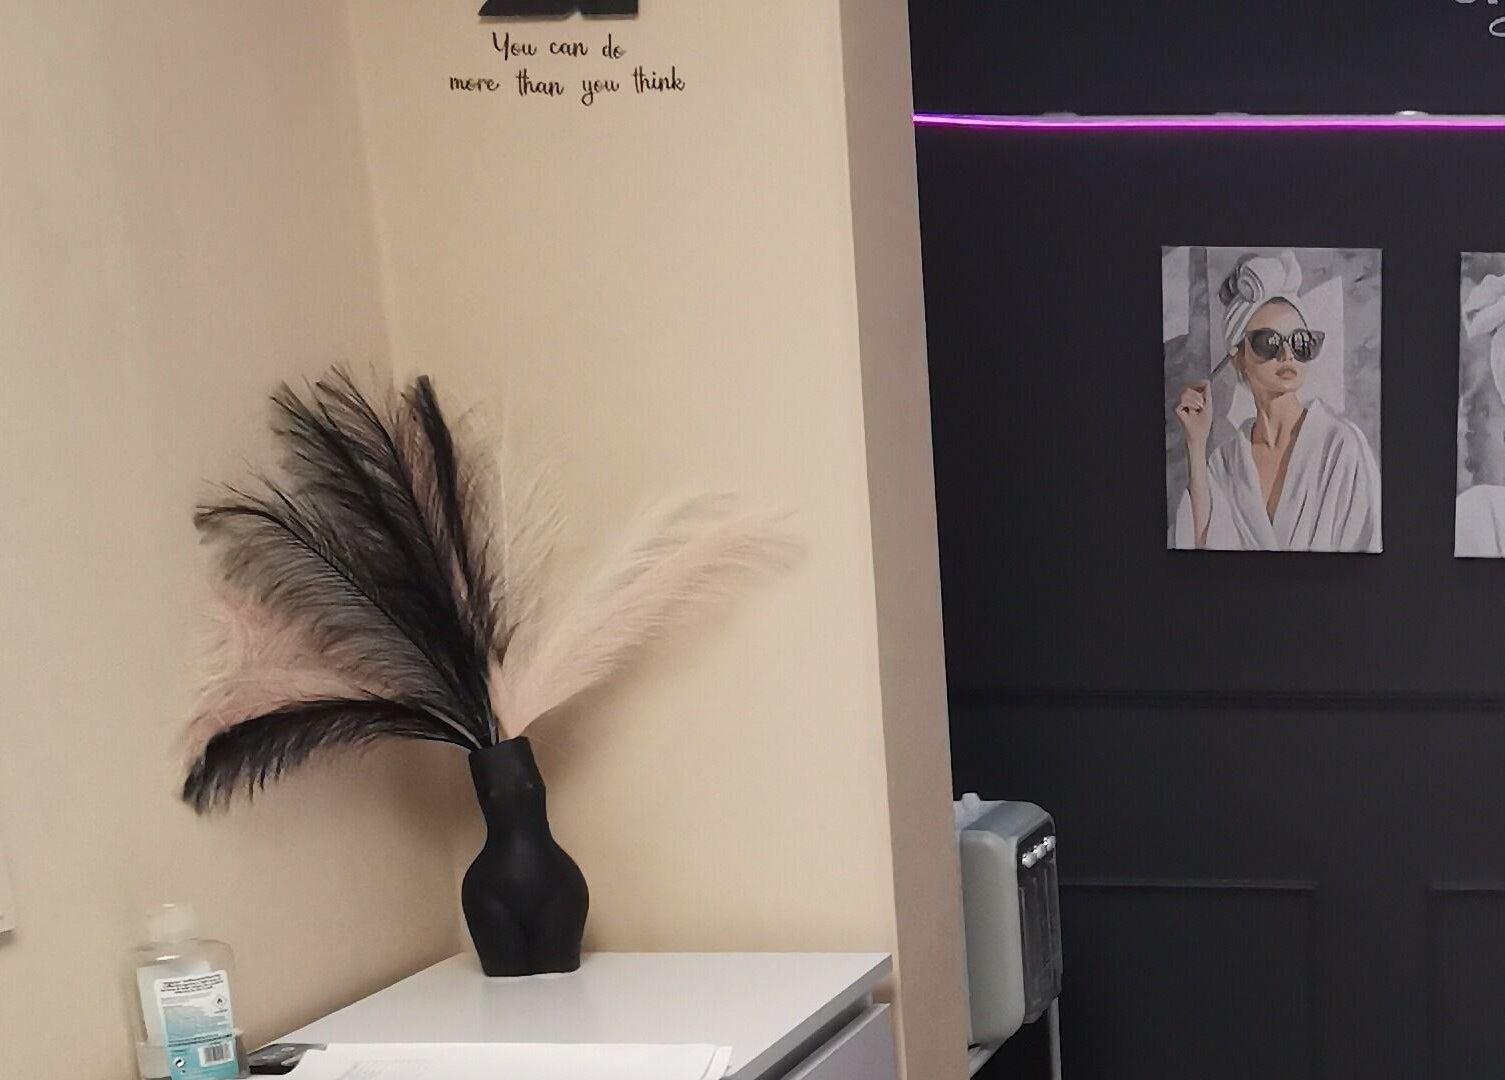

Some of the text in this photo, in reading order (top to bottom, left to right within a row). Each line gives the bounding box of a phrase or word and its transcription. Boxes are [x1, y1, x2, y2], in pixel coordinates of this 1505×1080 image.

[491, 31, 628, 61] You can do
[449, 65, 686, 106] more than you think
